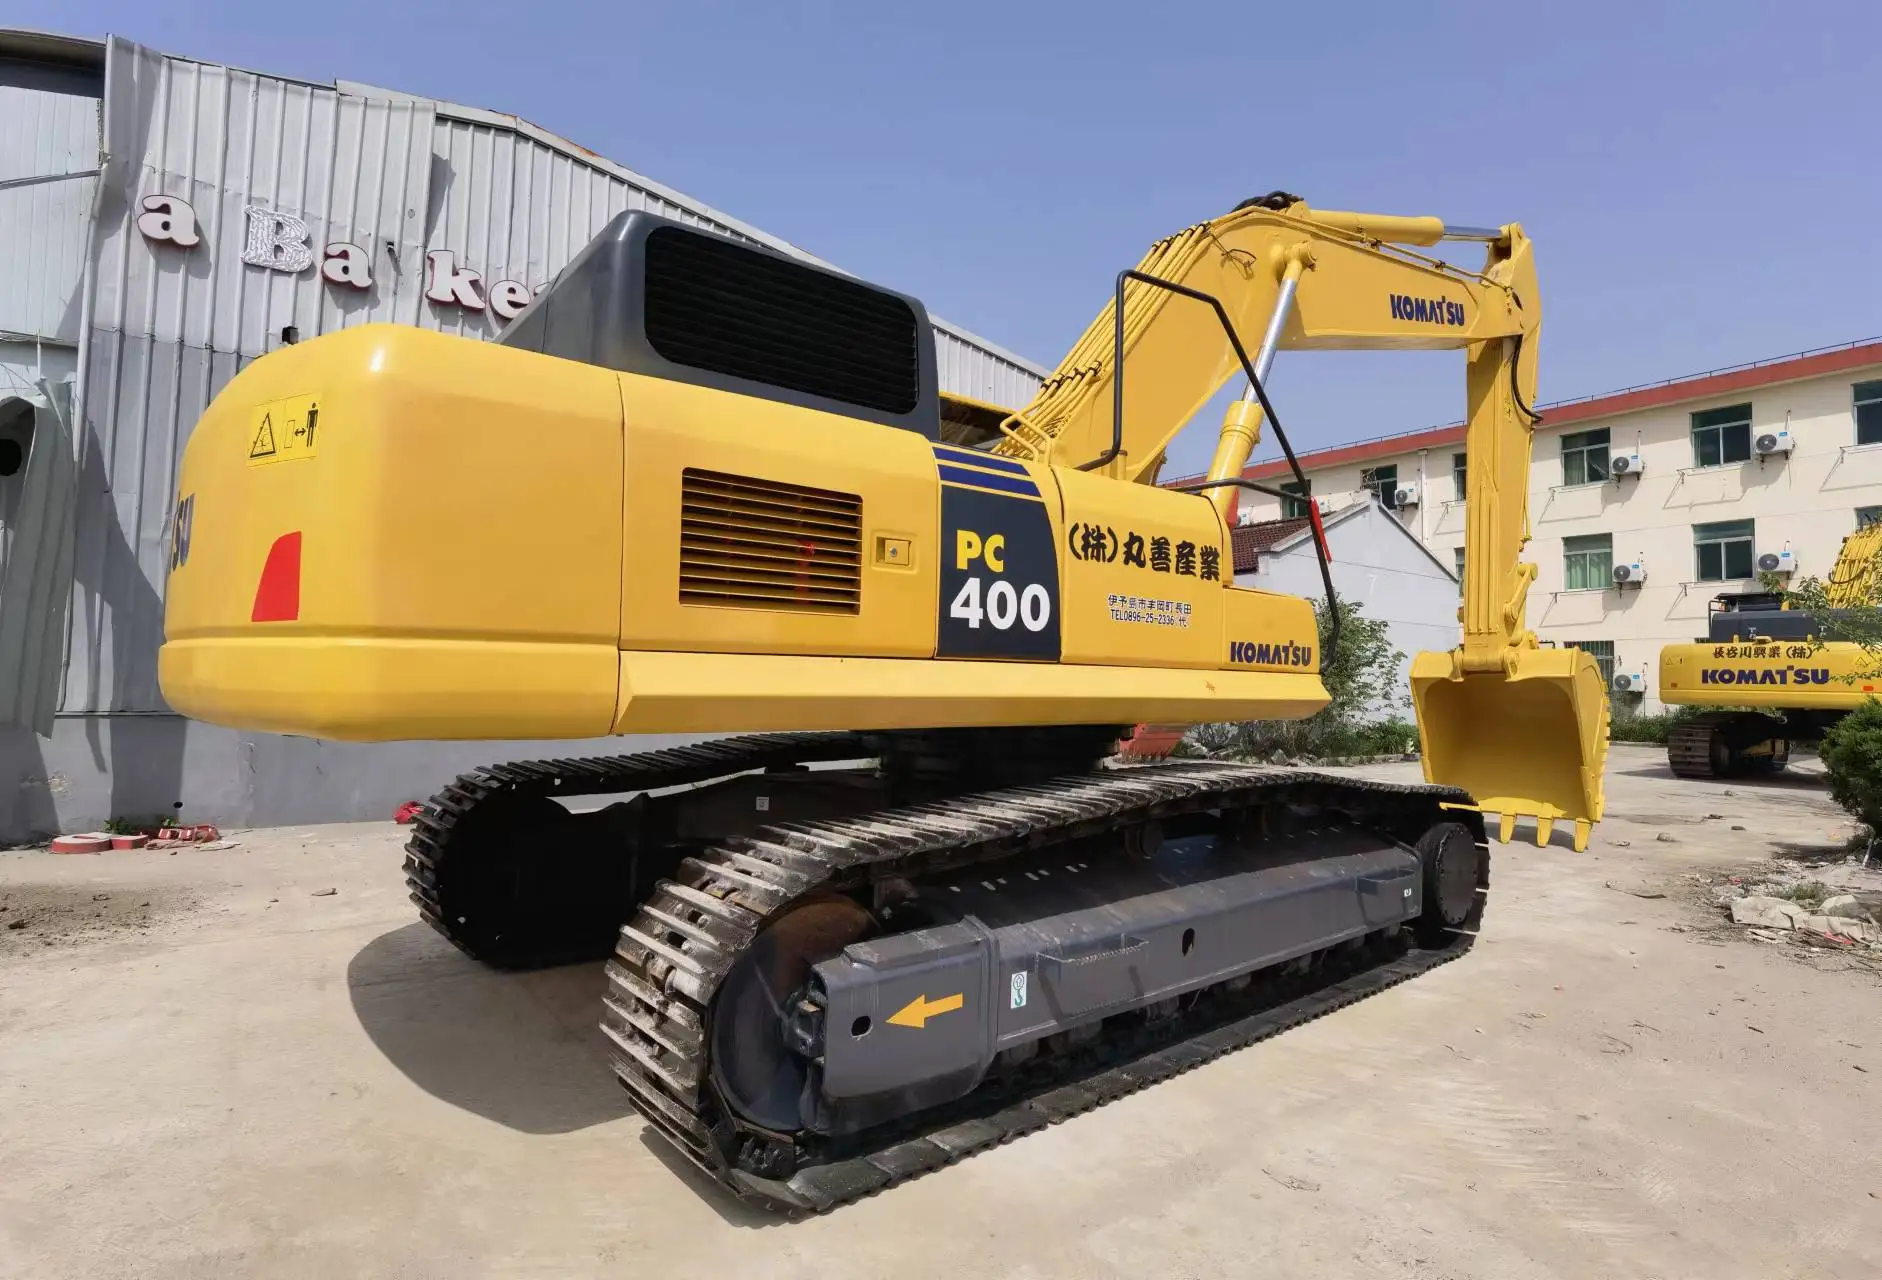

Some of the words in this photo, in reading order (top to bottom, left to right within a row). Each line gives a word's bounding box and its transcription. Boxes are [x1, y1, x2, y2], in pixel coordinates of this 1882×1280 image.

[137, 194, 199, 248] a
[240, 204, 554, 320] Bake
[1389, 293, 1465, 327] KOMATSU
[956, 529, 1005, 573] PC
[950, 577, 1051, 632] 400
[1230, 639, 1312, 667] KOMATSU
[1702, 665, 1830, 685] KOMATSU
